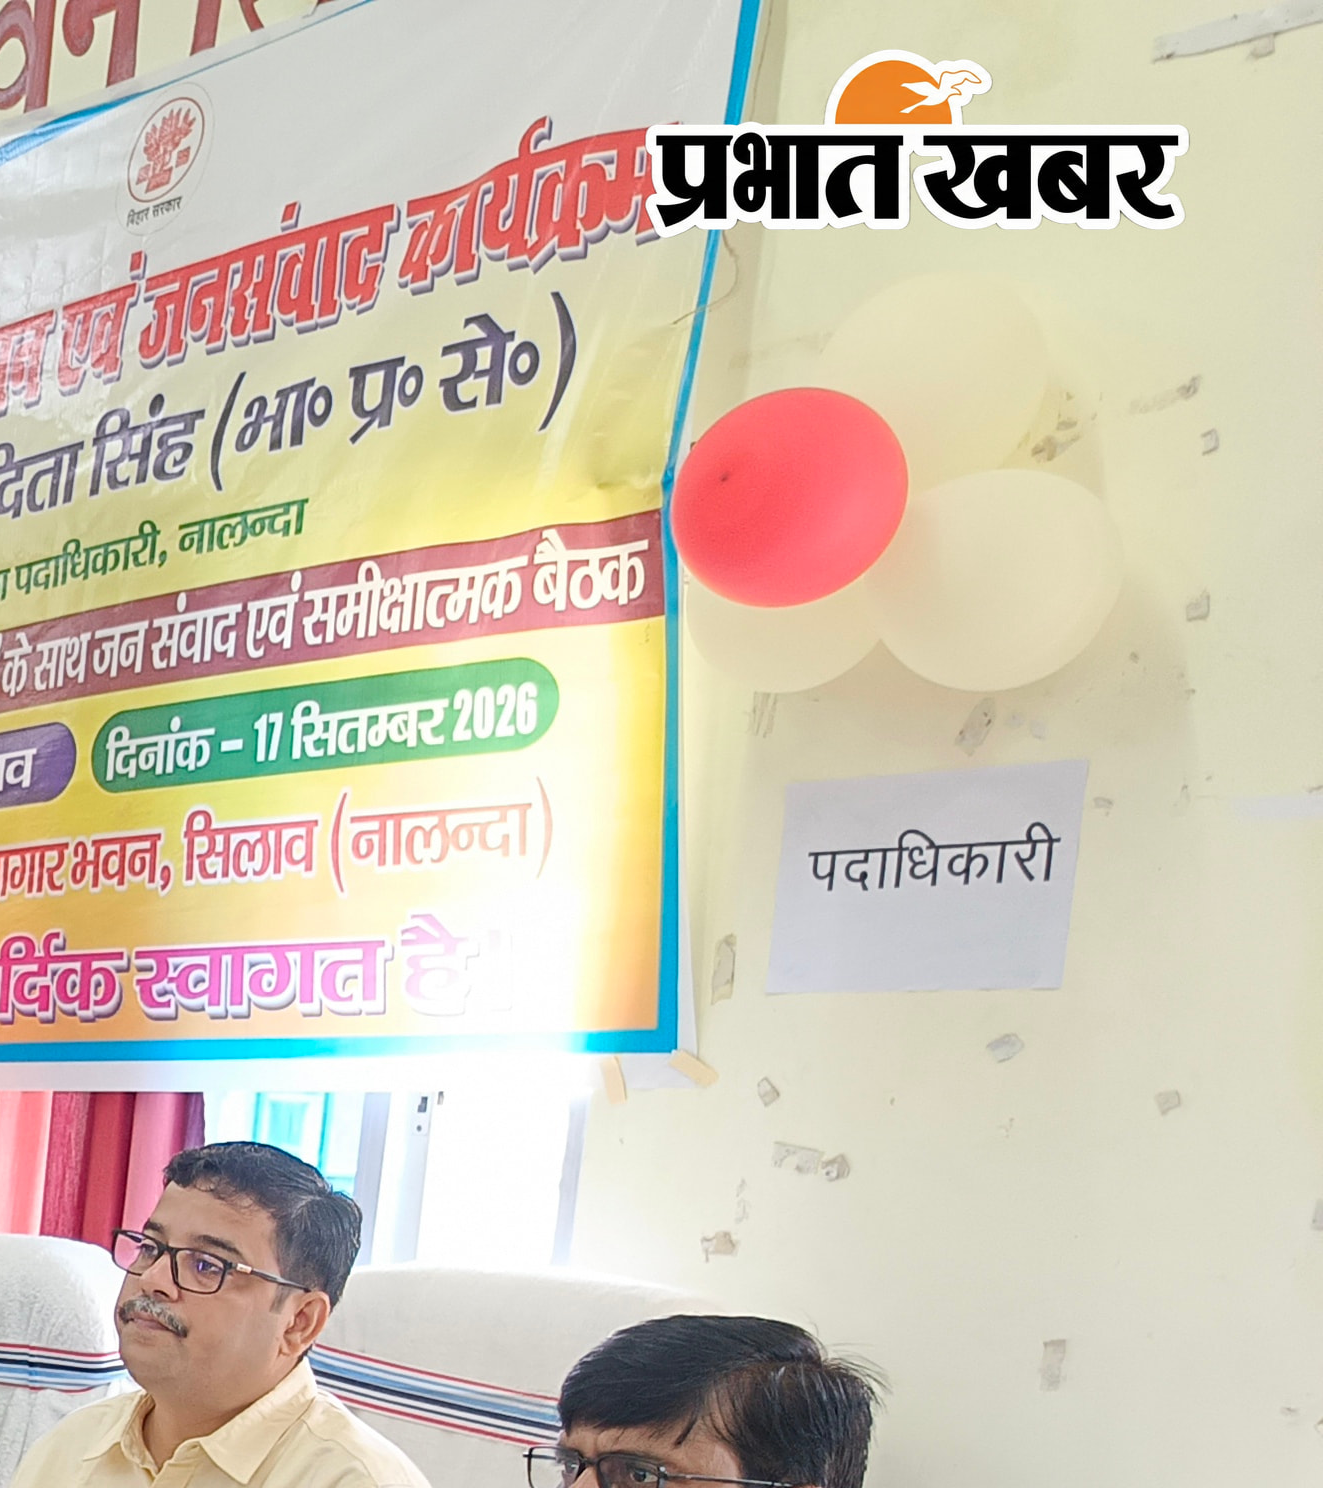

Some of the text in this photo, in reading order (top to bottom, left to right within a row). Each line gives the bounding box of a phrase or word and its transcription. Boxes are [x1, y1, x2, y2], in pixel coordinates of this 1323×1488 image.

[126, 196, 183, 227] बिहार सरकार
[56, 251, 147, 397] एवं
[138, 202, 401, 370] जनसंवाद
[89, 393, 205, 498] सिंह
[14, 523, 167, 607] पदाधिकारी,
[177, 498, 305, 562] नालन्दा
[2, 631, 32, 696] के
[34, 631, 91, 690] साथ
[93, 621, 149, 678] जन
[152, 591, 242, 669] संवाद
[246, 571, 302, 659] एवं
[302, 555, 529, 645] समीक्षात्मक
[532, 529, 649, 612] बैठक
[105, 681, 538, 782] दिनांक 17 सितम्बर 2026
[71, 832, 172, 893] भवन,
[183, 808, 319, 884] सिलाव
[808, 821, 1061, 892] पदाधिकारी
[134, 934, 397, 1024] स्वागत
